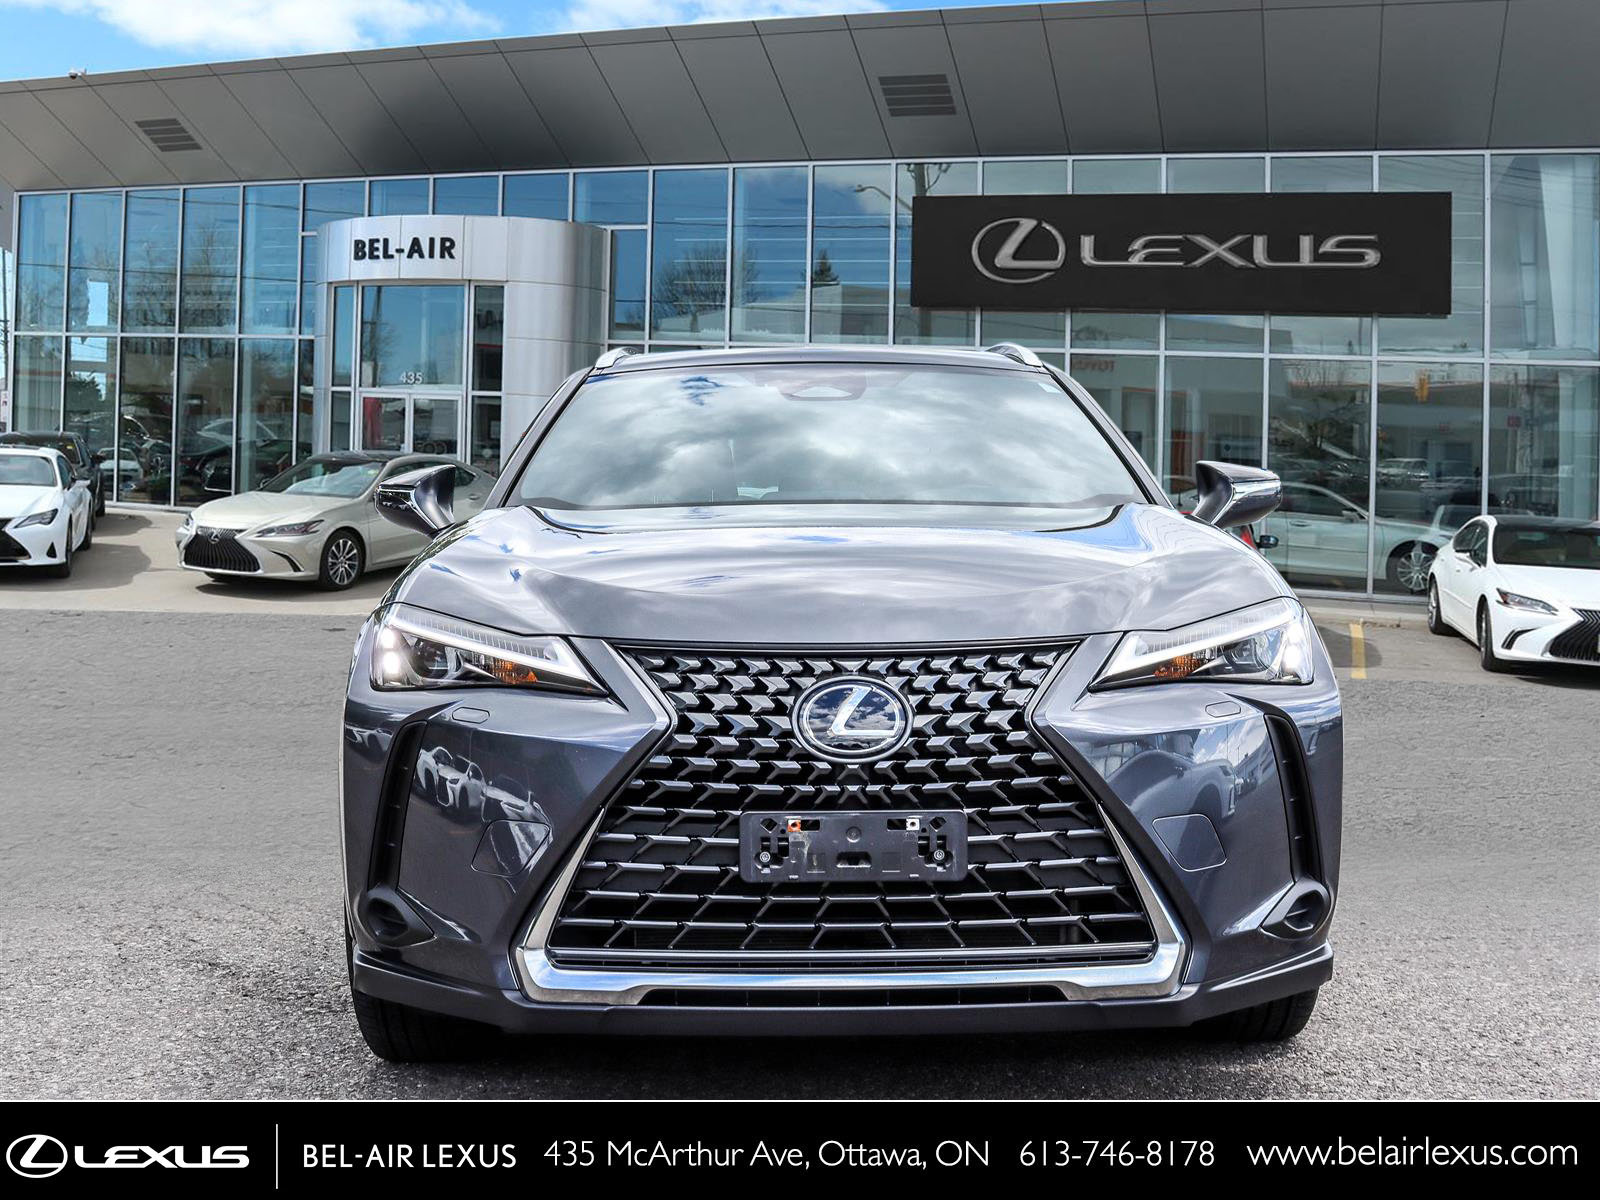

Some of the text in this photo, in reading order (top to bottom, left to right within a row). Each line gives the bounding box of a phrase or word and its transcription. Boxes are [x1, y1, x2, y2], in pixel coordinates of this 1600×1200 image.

[353, 236, 457, 261] BEL-AIR
[1080, 233, 1382, 268] LEXUS
[400, 371, 424, 385] 435
